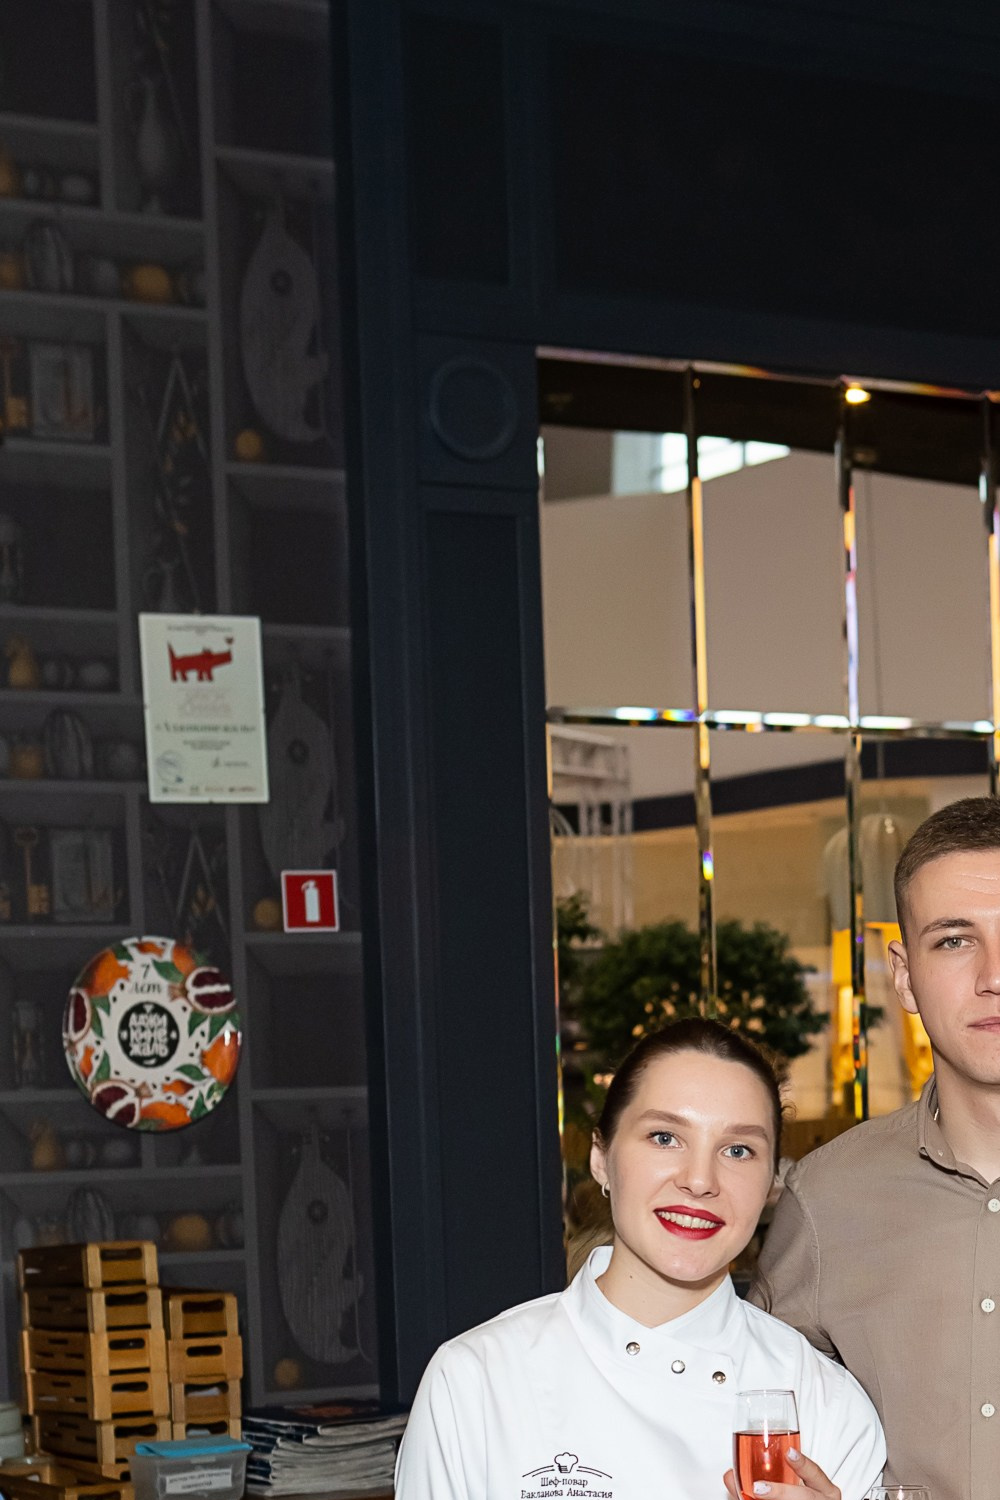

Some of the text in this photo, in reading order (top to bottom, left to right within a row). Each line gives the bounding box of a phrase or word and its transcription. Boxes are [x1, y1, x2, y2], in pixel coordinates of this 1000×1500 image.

[141, 963, 150, 979] 7
[541, 1476, 588, 1488] Шеф-повар
[567, 1488, 612, 1498] Анастасия
